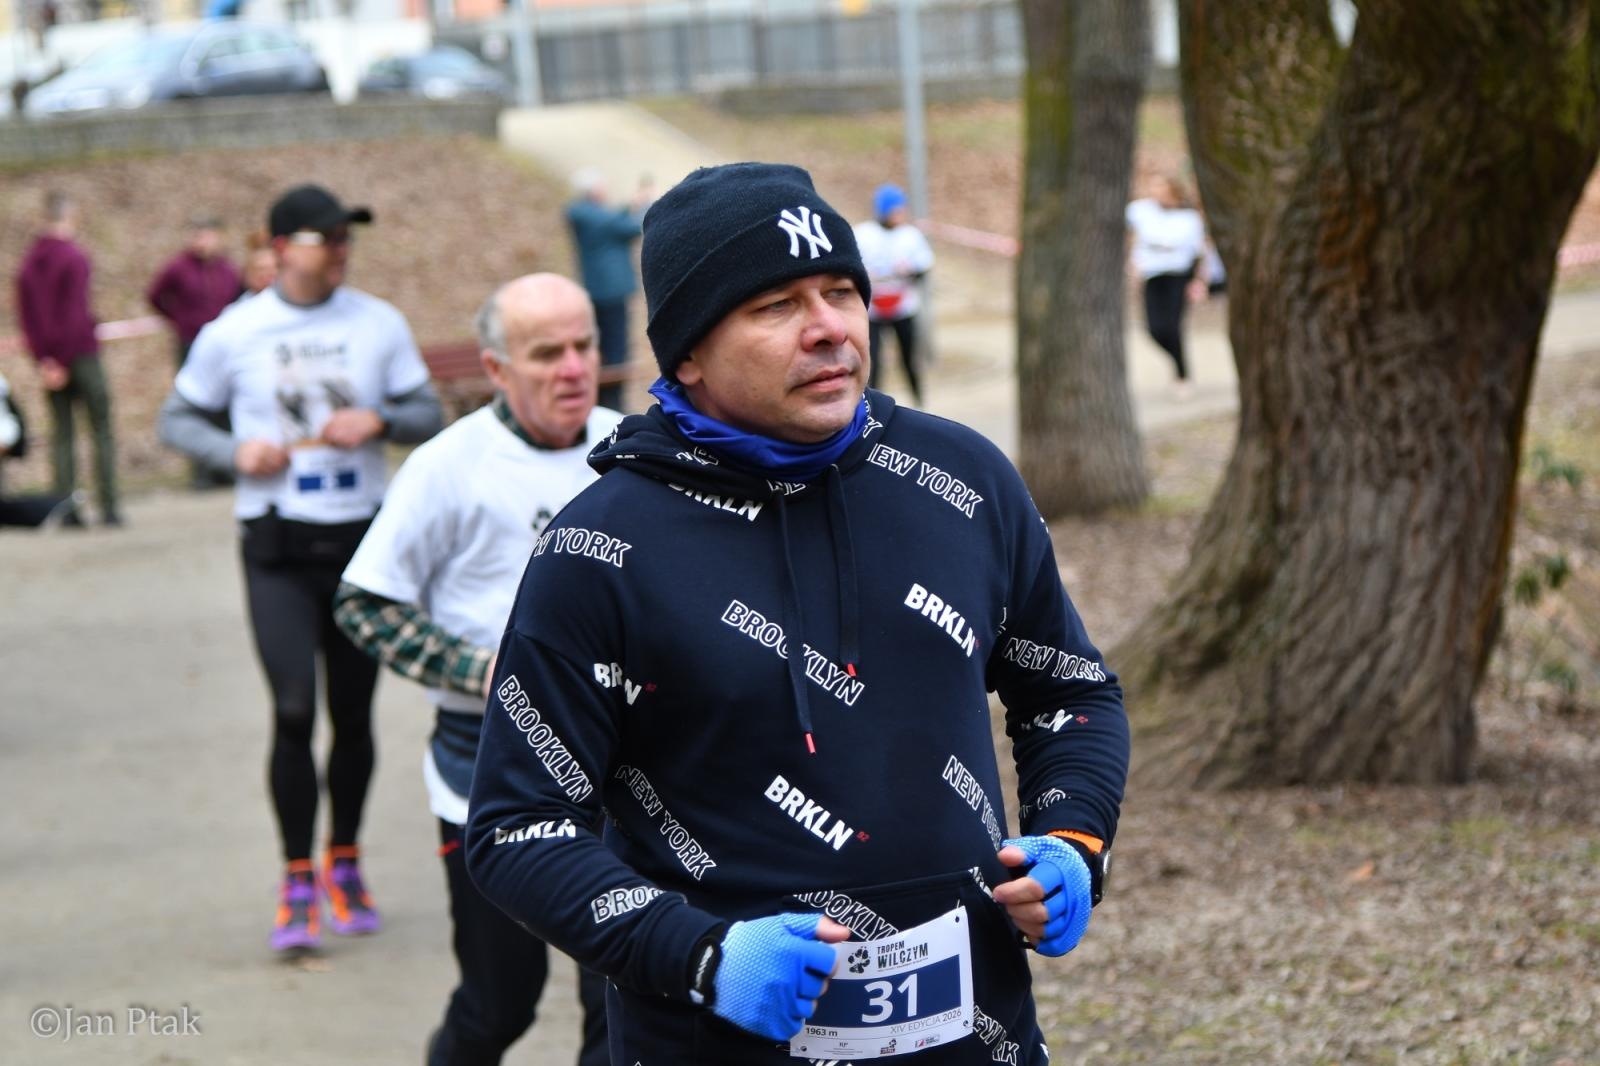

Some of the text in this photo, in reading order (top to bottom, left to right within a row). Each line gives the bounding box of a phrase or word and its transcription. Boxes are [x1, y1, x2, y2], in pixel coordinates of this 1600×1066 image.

[778, 206, 832, 259] NY
[917, 462, 984, 518] YORK
[554, 528, 632, 567] YORK
[904, 583, 975, 657] BRKLN
[1003, 637, 1106, 682] NEW YORK
[497, 674, 594, 803] BROOKLYN
[942, 754, 984, 811] NEW
[615, 764, 717, 881] NEW YORK
[763, 774, 854, 851] BRKLN
[877, 940, 905, 955] TROPEM
[877, 942, 928, 969] WILCZYM
[861, 973, 918, 1024] 31
[890, 1009, 961, 1034] XIV EDYCJA 2026
[806, 1027, 826, 1036] 1963
